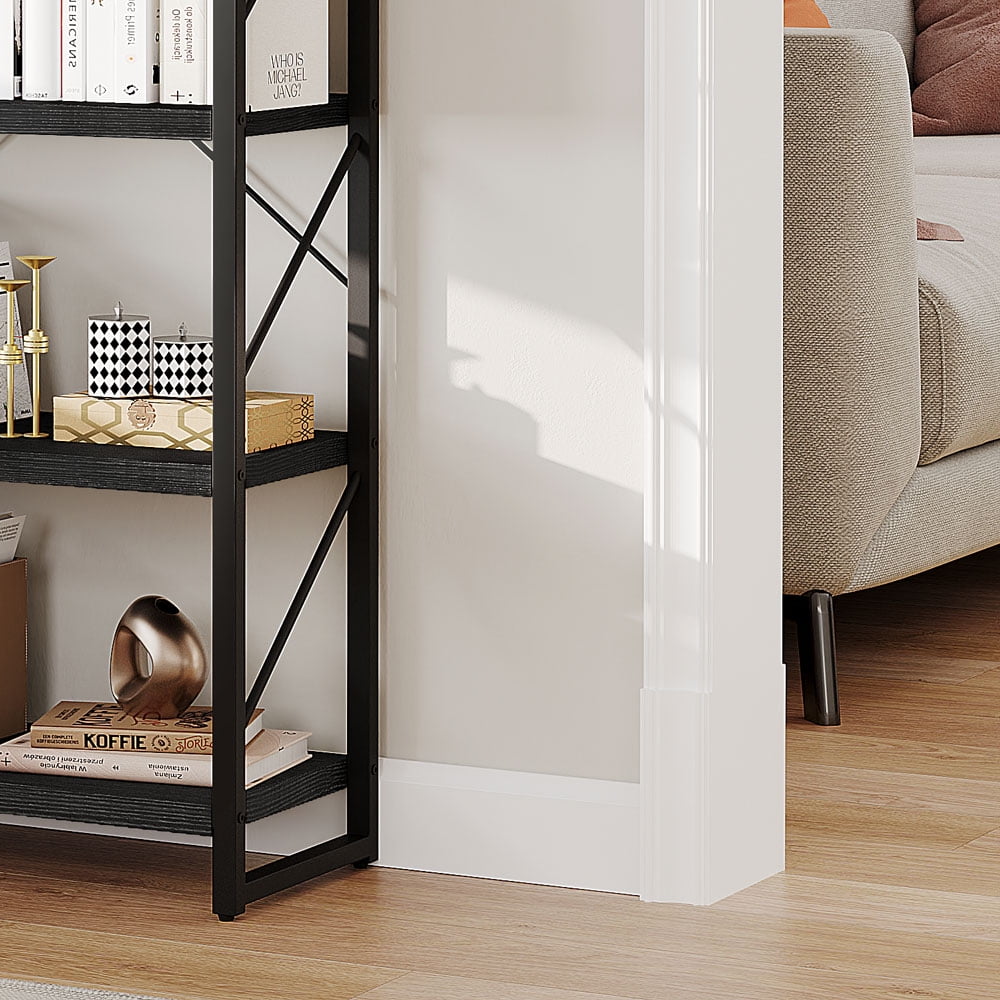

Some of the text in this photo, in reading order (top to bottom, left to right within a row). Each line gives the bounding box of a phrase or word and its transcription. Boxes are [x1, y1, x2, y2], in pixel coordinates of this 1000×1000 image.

[270, 51, 304, 68] WHO IS
[267, 67, 308, 85] MICHAEL
[273, 83, 302, 100] JANG?
[83, 733, 147, 750] KOFFIE
[175, 735, 213, 753] STORIE
[22, 752, 57, 762] obrazów
[61, 756, 104, 765] przestrzeni
[40, 762, 88, 773] W labiryncie
[148, 763, 190, 773] ustawienia
[154, 771, 183, 780] Zmiana
